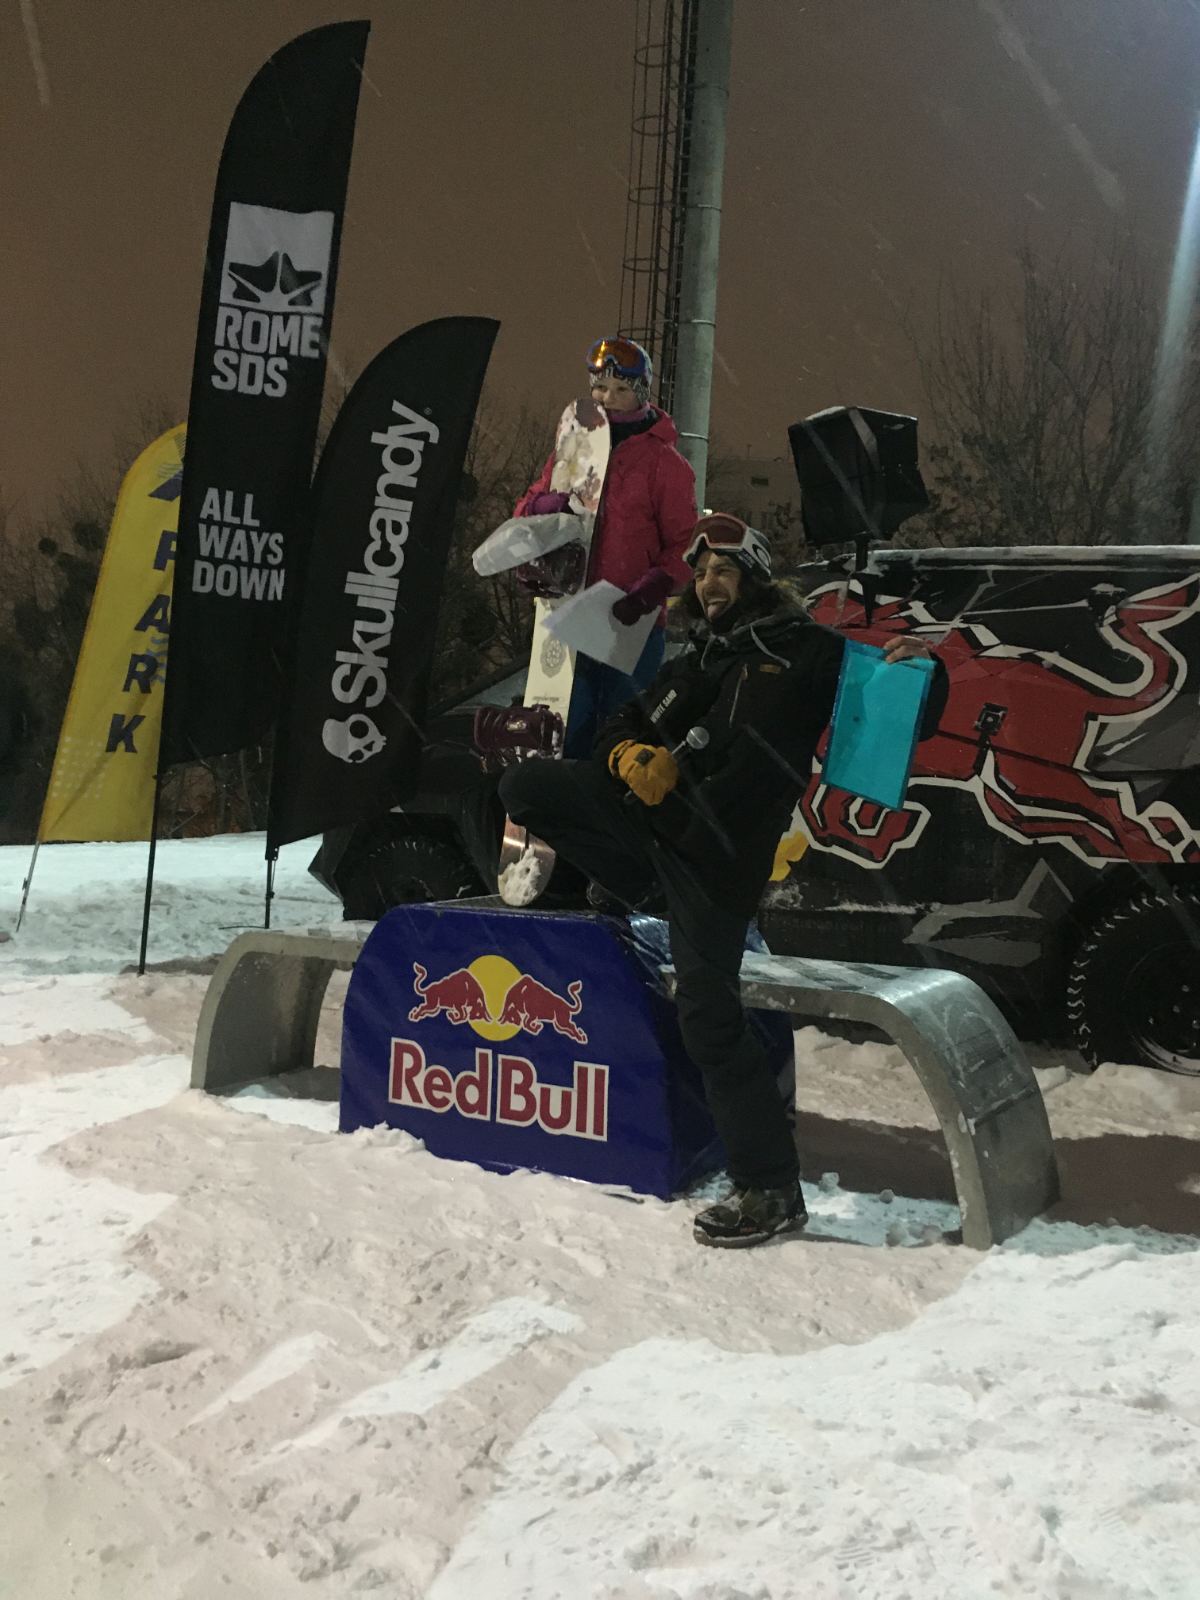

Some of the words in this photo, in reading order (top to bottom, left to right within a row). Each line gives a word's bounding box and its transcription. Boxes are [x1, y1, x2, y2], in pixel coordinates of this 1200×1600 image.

[214, 305, 324, 359] ROME
[211, 348, 289, 398] SDS
[199, 487, 260, 527] ALL
[198, 523, 284, 565] WAYS
[331, 399, 439, 708] Skullcandy
[192, 559, 285, 601] DOWN
